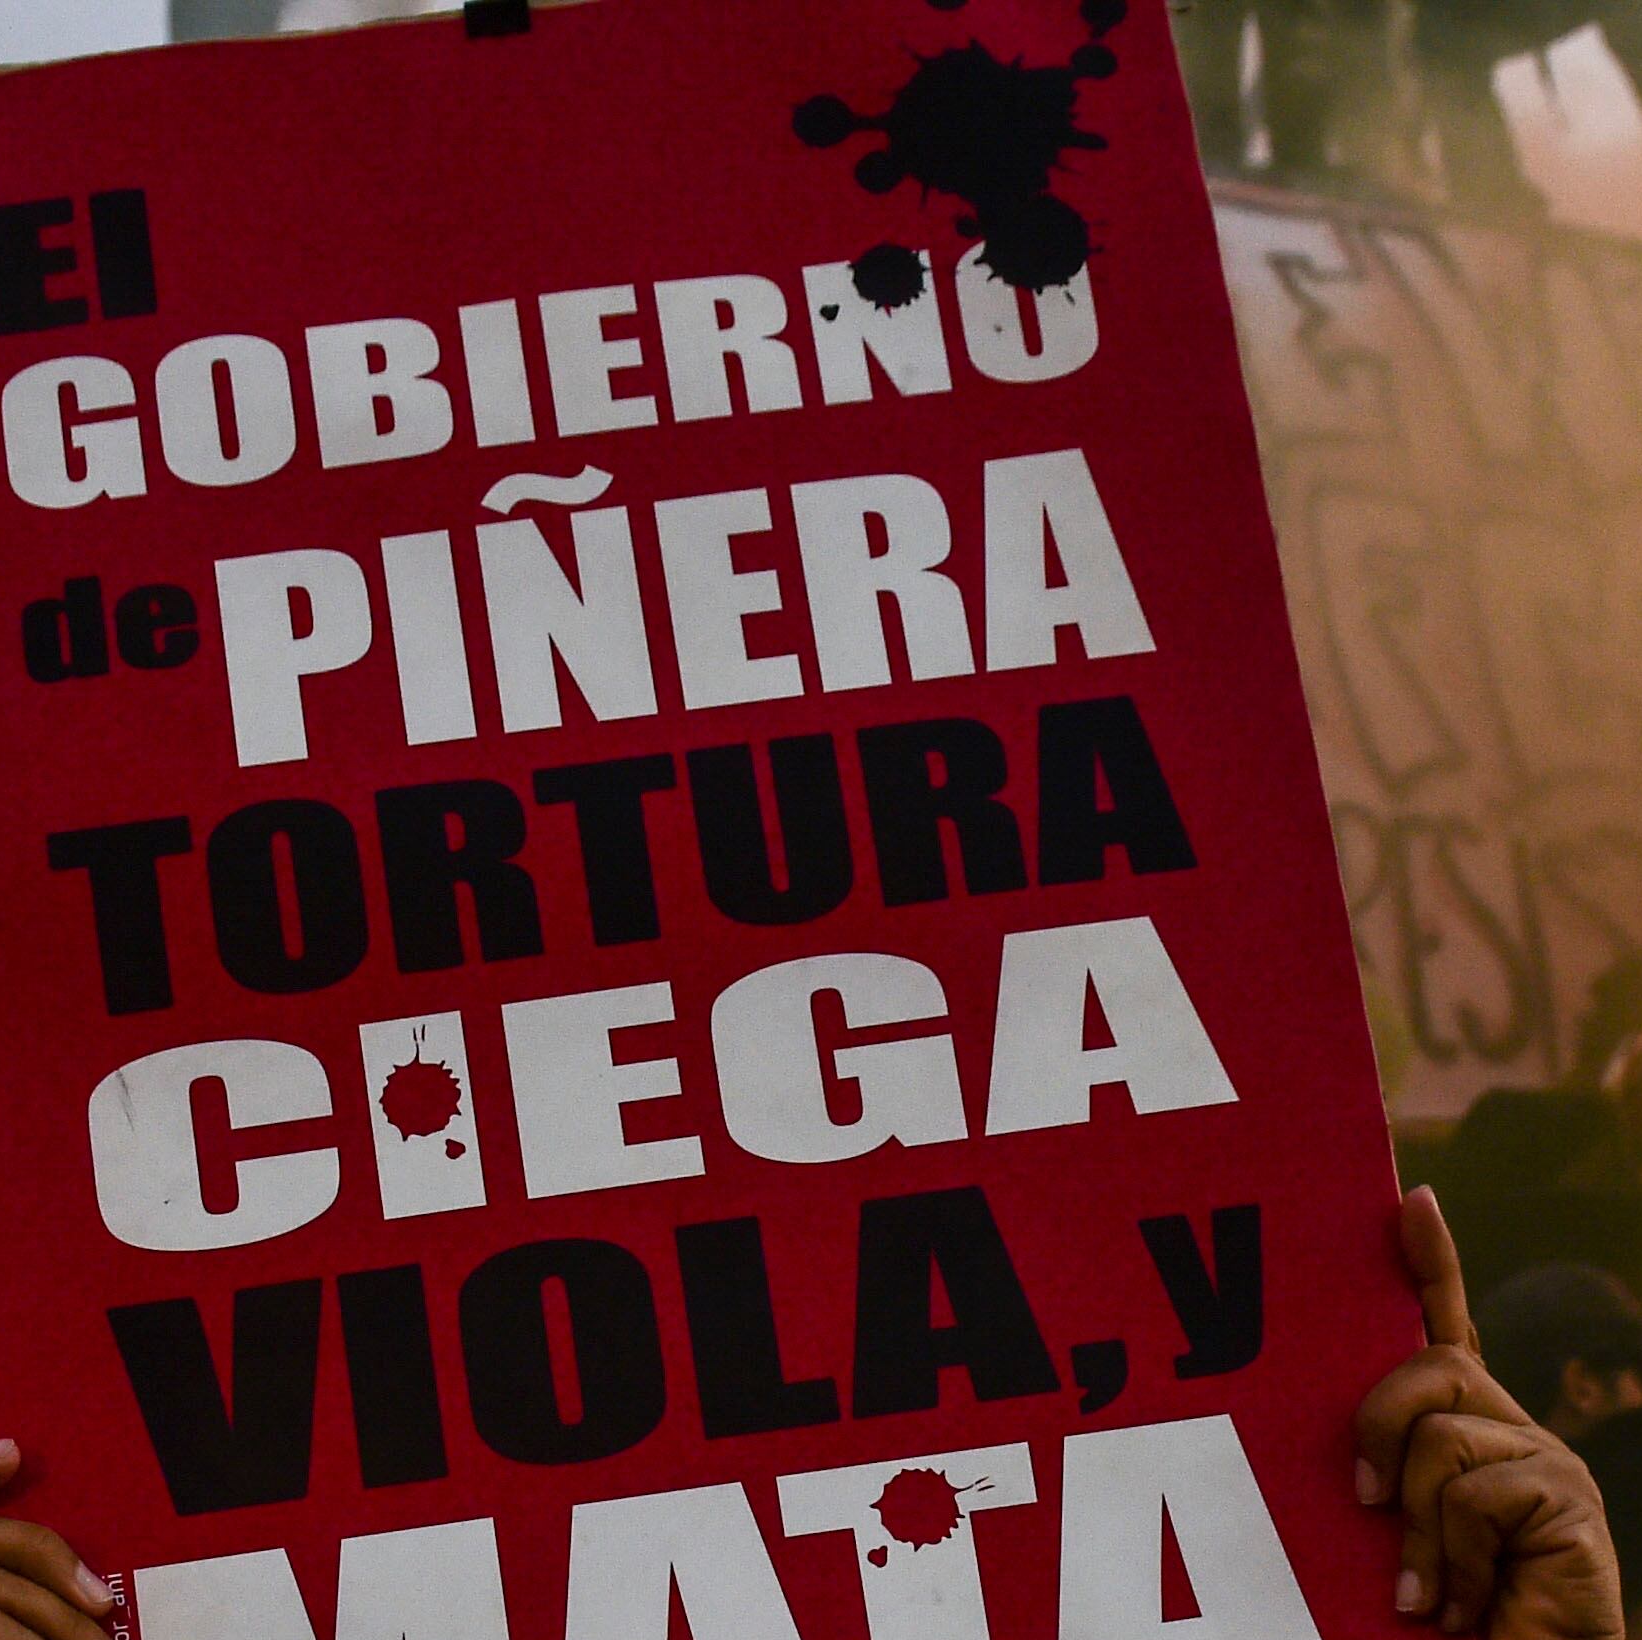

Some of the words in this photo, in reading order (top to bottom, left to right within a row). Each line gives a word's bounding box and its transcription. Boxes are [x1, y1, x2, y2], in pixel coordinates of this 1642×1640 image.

[0, 238, 1099, 510] GOBIERNO
[20, 575, 200, 685] de
[214, 447, 1157, 768] PIÑERA
[46, 695, 1198, 1017] TORTURA
[88, 915, 1241, 1252] CIEGA
